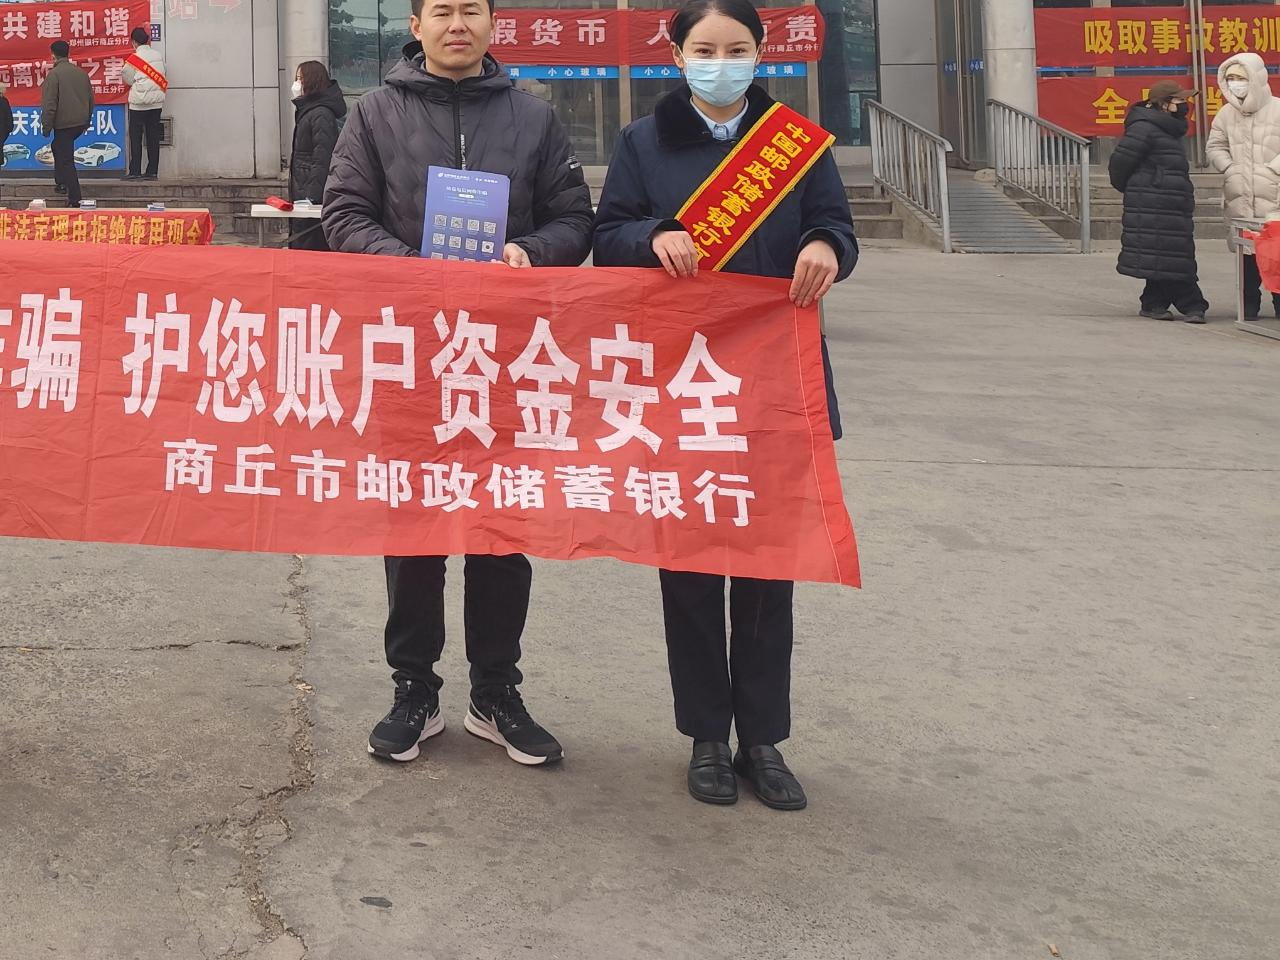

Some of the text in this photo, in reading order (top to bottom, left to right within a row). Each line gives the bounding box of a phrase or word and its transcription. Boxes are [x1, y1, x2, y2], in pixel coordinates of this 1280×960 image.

[3, 8, 130, 40] 共建和谐
[763, 43, 820, 53] 行商丘市分行
[547, 67, 607, 78] 小心玻璃
[92, 85, 125, 94] 商丘分行
[123, 292, 749, 456] 护您账户资金安全
[163, 438, 756, 528] 商丘市邮政储蓄银行
